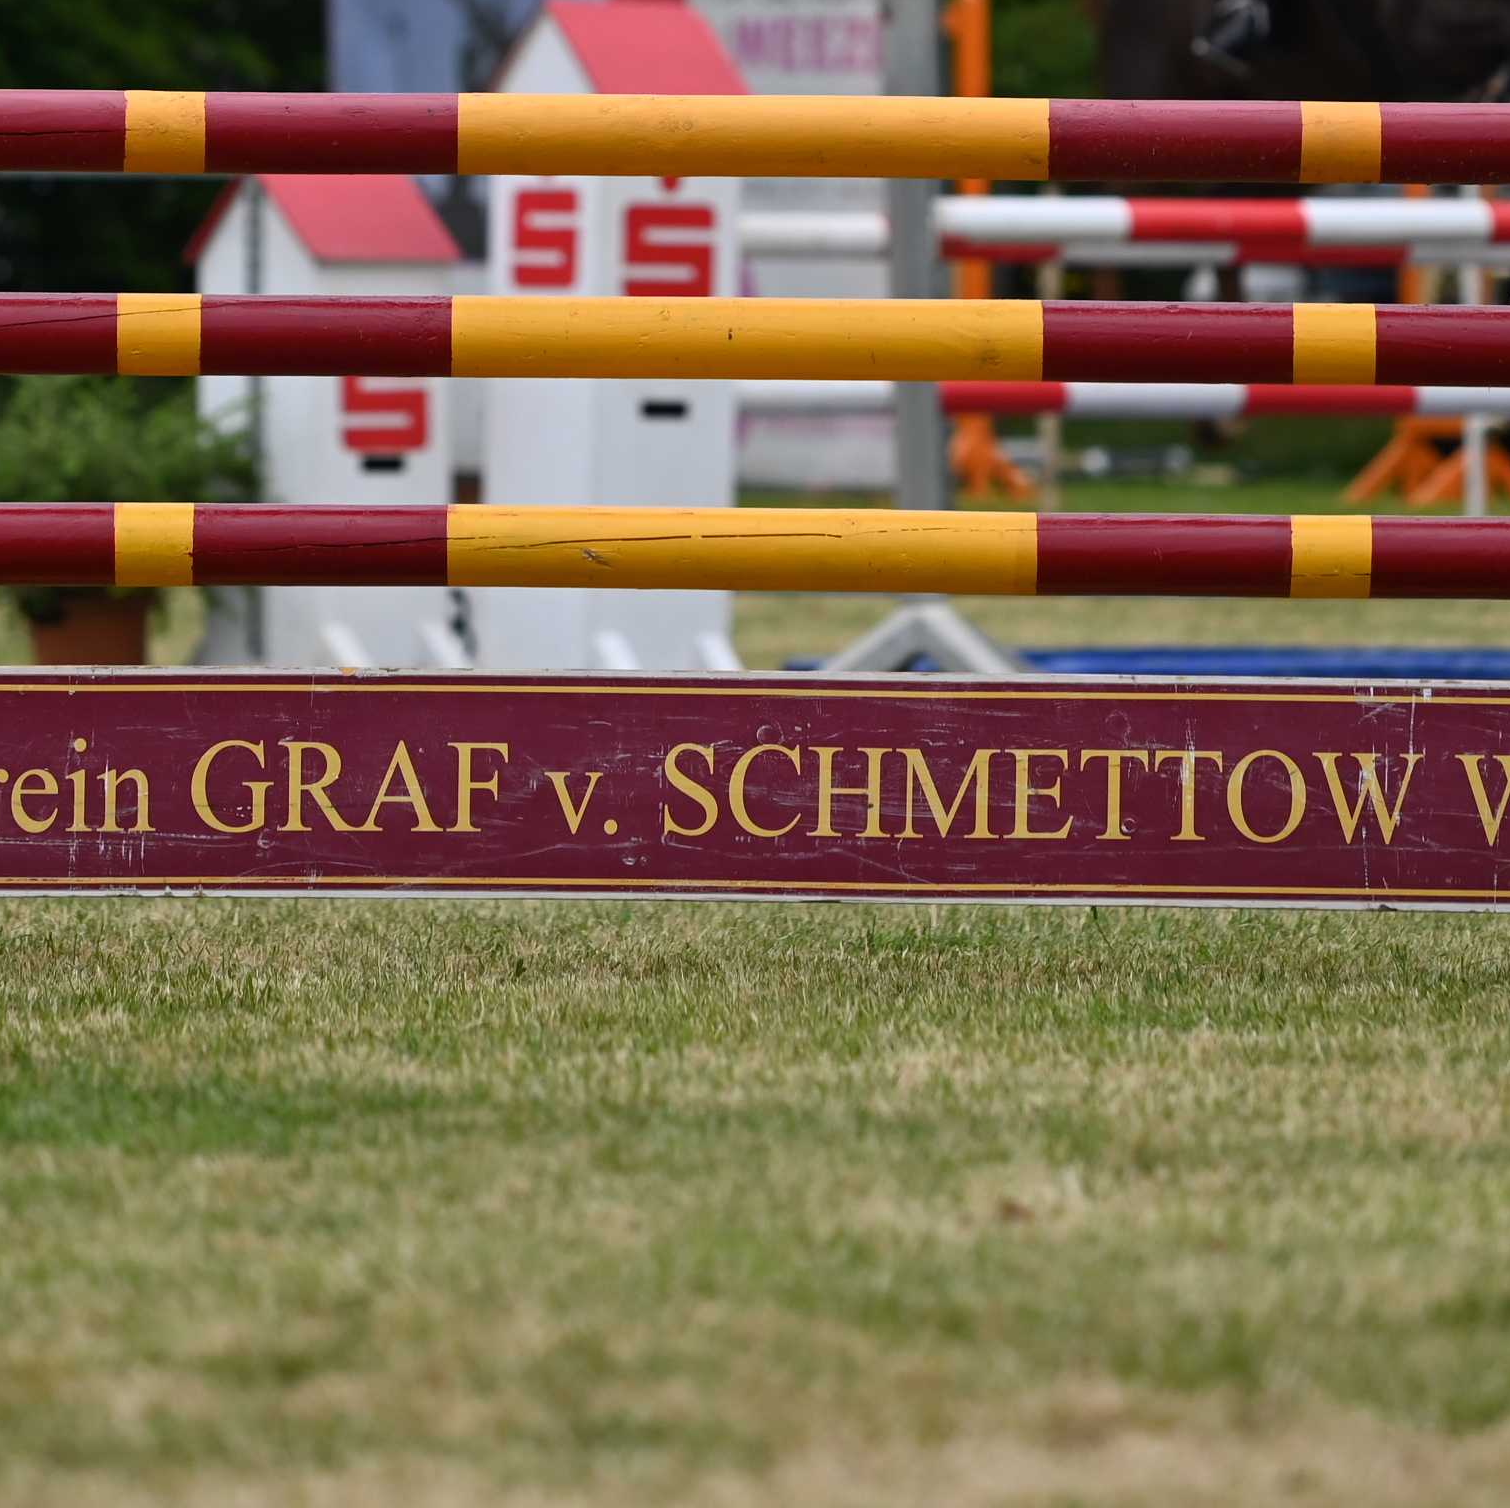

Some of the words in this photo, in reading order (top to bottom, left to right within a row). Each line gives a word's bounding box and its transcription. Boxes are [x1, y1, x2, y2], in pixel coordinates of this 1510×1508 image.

[190, 739, 511, 835] GRAF
[544, 770, 620, 835] v.
[663, 742, 1426, 844] SCHMETTOW
